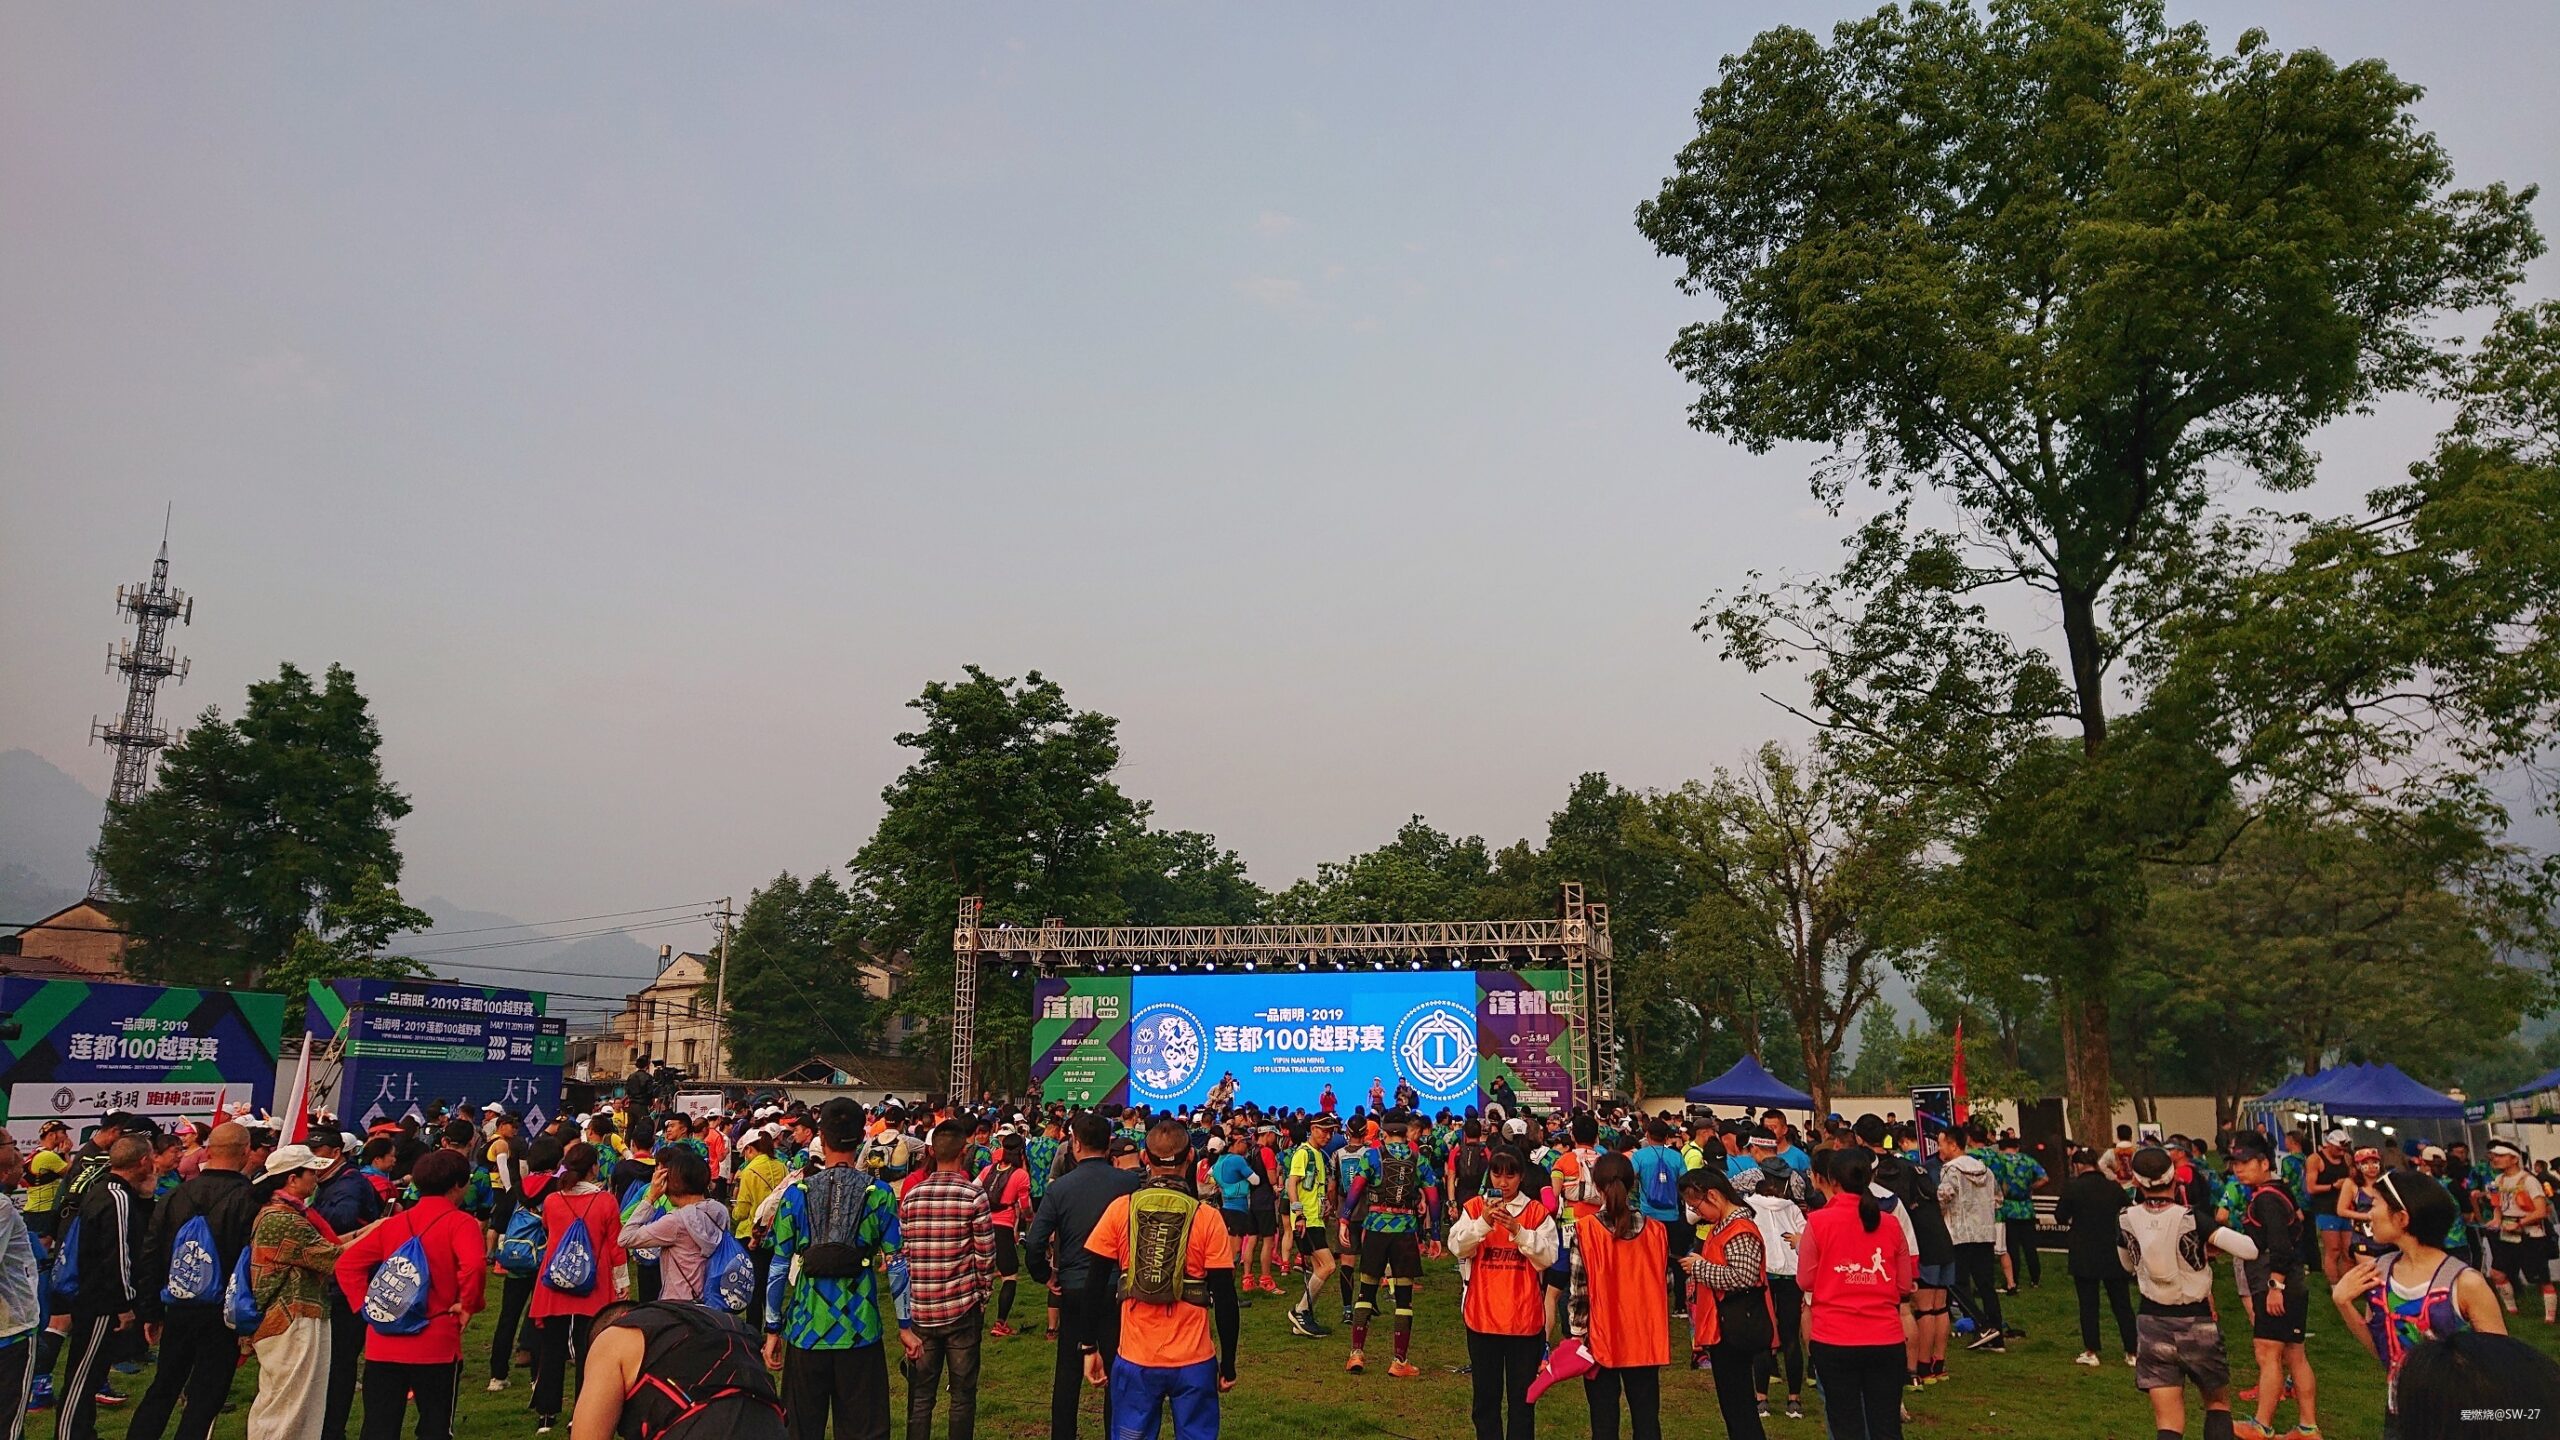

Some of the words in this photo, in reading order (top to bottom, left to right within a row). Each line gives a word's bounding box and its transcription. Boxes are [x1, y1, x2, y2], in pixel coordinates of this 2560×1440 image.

[460, 997, 535, 1017] 莲都100越野赛
[1096, 995, 1119, 1006] 100
[1254, 1008, 1344, 1023] 一品南明·2019
[111, 1018, 189, 1032] 一品南明·2019
[426, 1023, 483, 1037] 莲都100越野赛
[69, 1033, 219, 1062] 莲都100越野赛
[1214, 1025, 1385, 1053] 莲都100越野赛
[511, 1043, 532, 1055] 丽水
[501, 1076, 541, 1104] 天下
[79, 1091, 139, 1108] 一品南明
[146, 1091, 181, 1105] 跑神
[191, 1096, 215, 1106] CHINA
[1151, 1222, 1168, 1283] ULTIMATE
